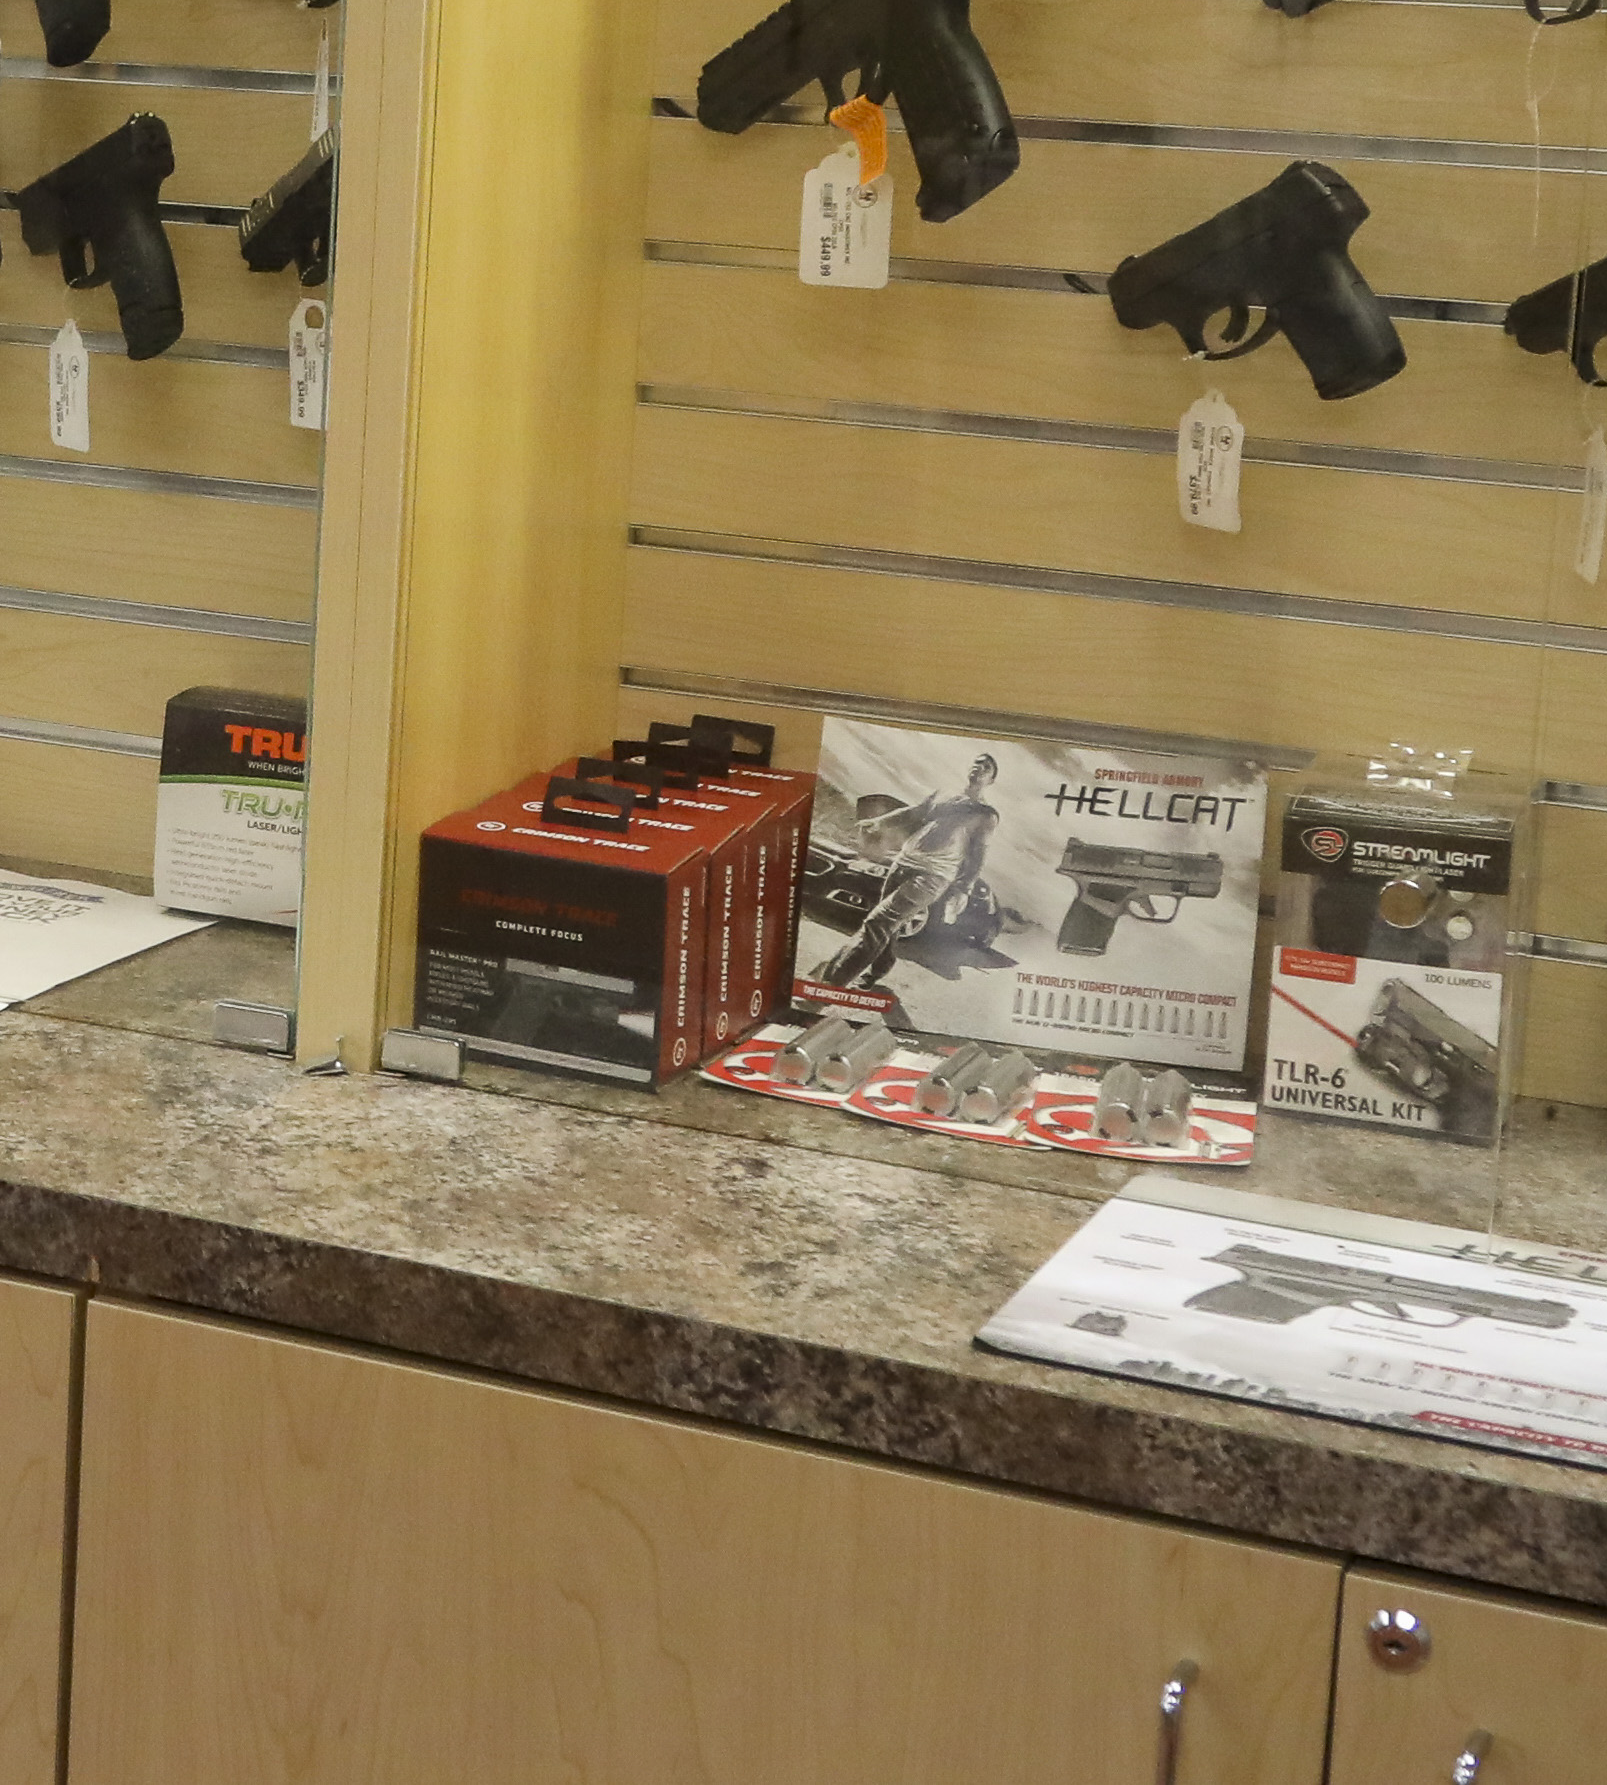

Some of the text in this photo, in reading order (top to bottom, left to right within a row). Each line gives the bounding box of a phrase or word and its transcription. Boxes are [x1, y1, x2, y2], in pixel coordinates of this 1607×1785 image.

[819, 235, 831, 276] $449.99
[248, 760, 275, 772] WHEN
[1094, 768, 1204, 788] SPRINGFIELD ARMORY
[708, 784, 761, 797] TRACE
[673, 799, 729, 812] TRACE
[1044, 783, 1247, 832] HELLCAT
[639, 818, 694, 832] TRACE
[511, 826, 650, 853] CRIMSON TRACE
[790, 828, 799, 881] TRACE
[1353, 842, 1491, 869] STREAMLIGHT
[754, 845, 767, 980] CRIMSON TRACE
[496, 920, 583, 942] COMPLETE FOCUS
[720, 865, 733, 1002] CRIMSON TRACE
[677, 886, 690, 1027] CRIMSON TRACE
[1017, 972, 1033, 983] THE
[1035, 975, 1076, 989] WORLD'S
[1078, 980, 1118, 994] HIGHEST
[1119, 985, 1164, 999] CAPACITY
[1425, 973, 1492, 989] 100 LUMENS
[816, 986, 849, 1002] CAPACITY
[858, 994, 886, 1008] DEFEND
[1274, 1058, 1346, 1089] TLR-6
[1272, 1085, 1426, 1122] UNIVERSAL KIT
